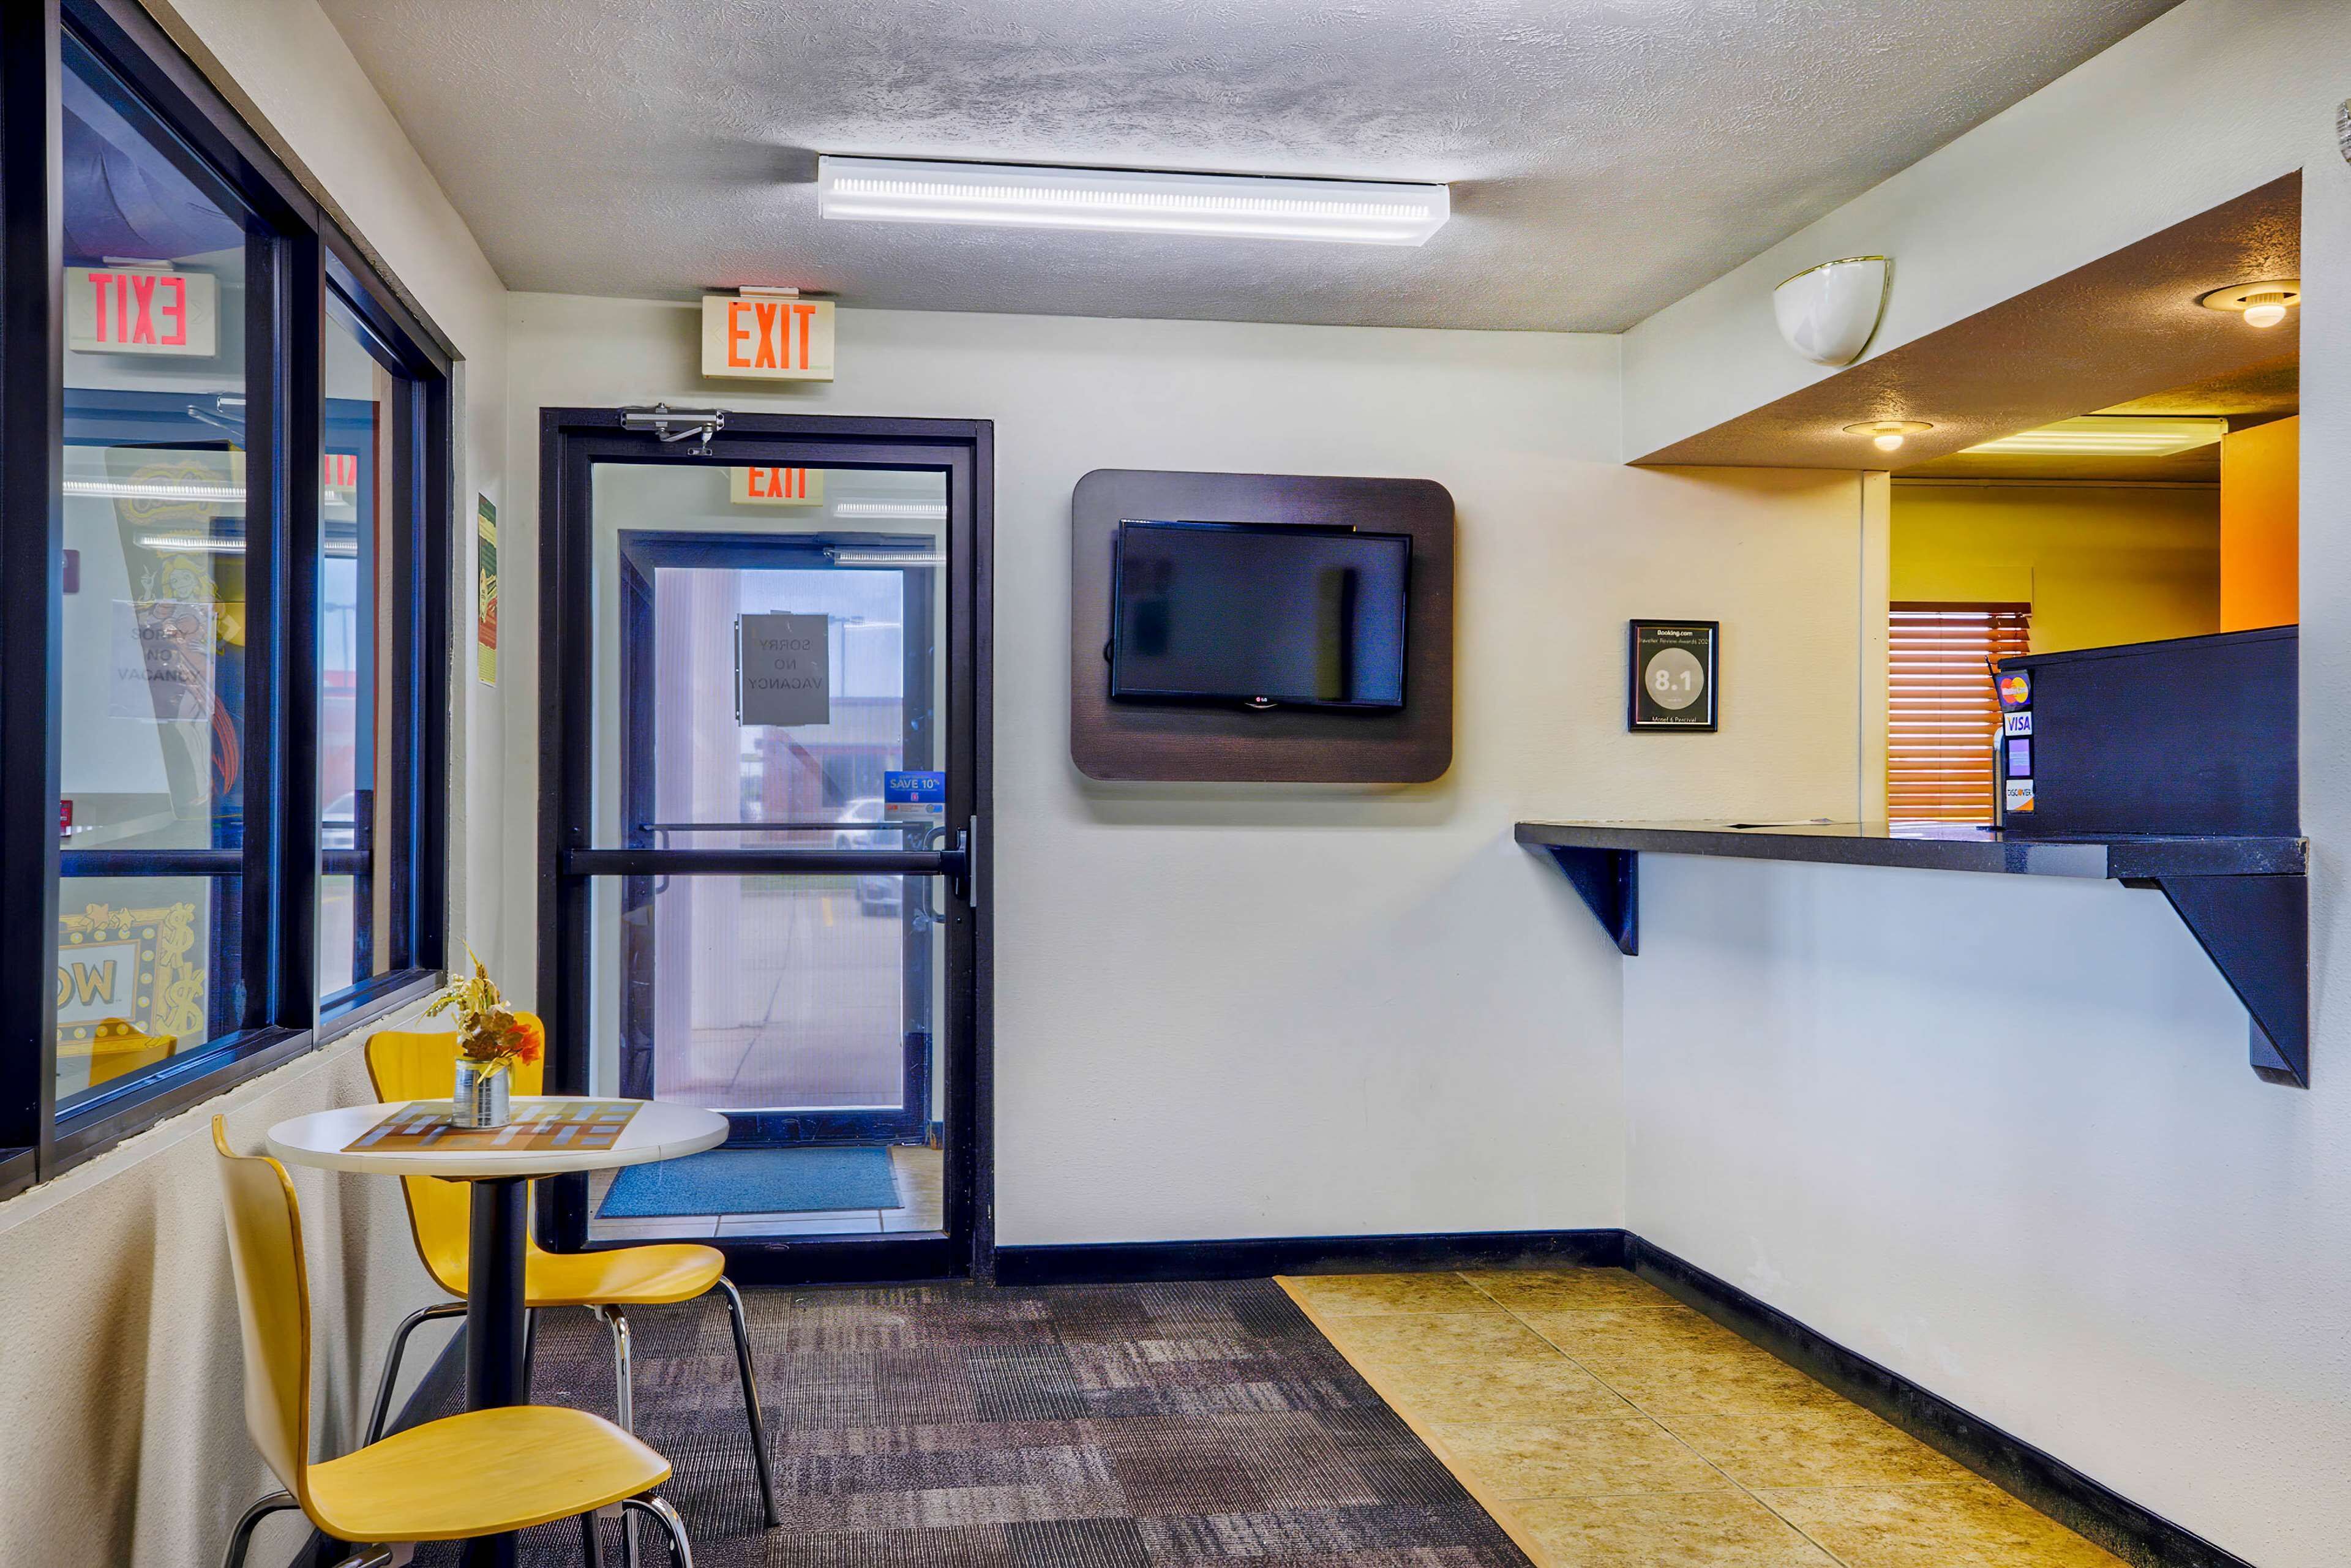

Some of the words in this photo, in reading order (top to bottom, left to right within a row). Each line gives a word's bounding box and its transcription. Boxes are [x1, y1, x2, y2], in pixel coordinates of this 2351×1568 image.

[728, 302, 816, 369] EXIT
[146, 649, 172, 661] NO
[1655, 670, 1690, 691] 8.1
[2008, 716, 2030, 731] VISA
[890, 779, 918, 789] SAVE
